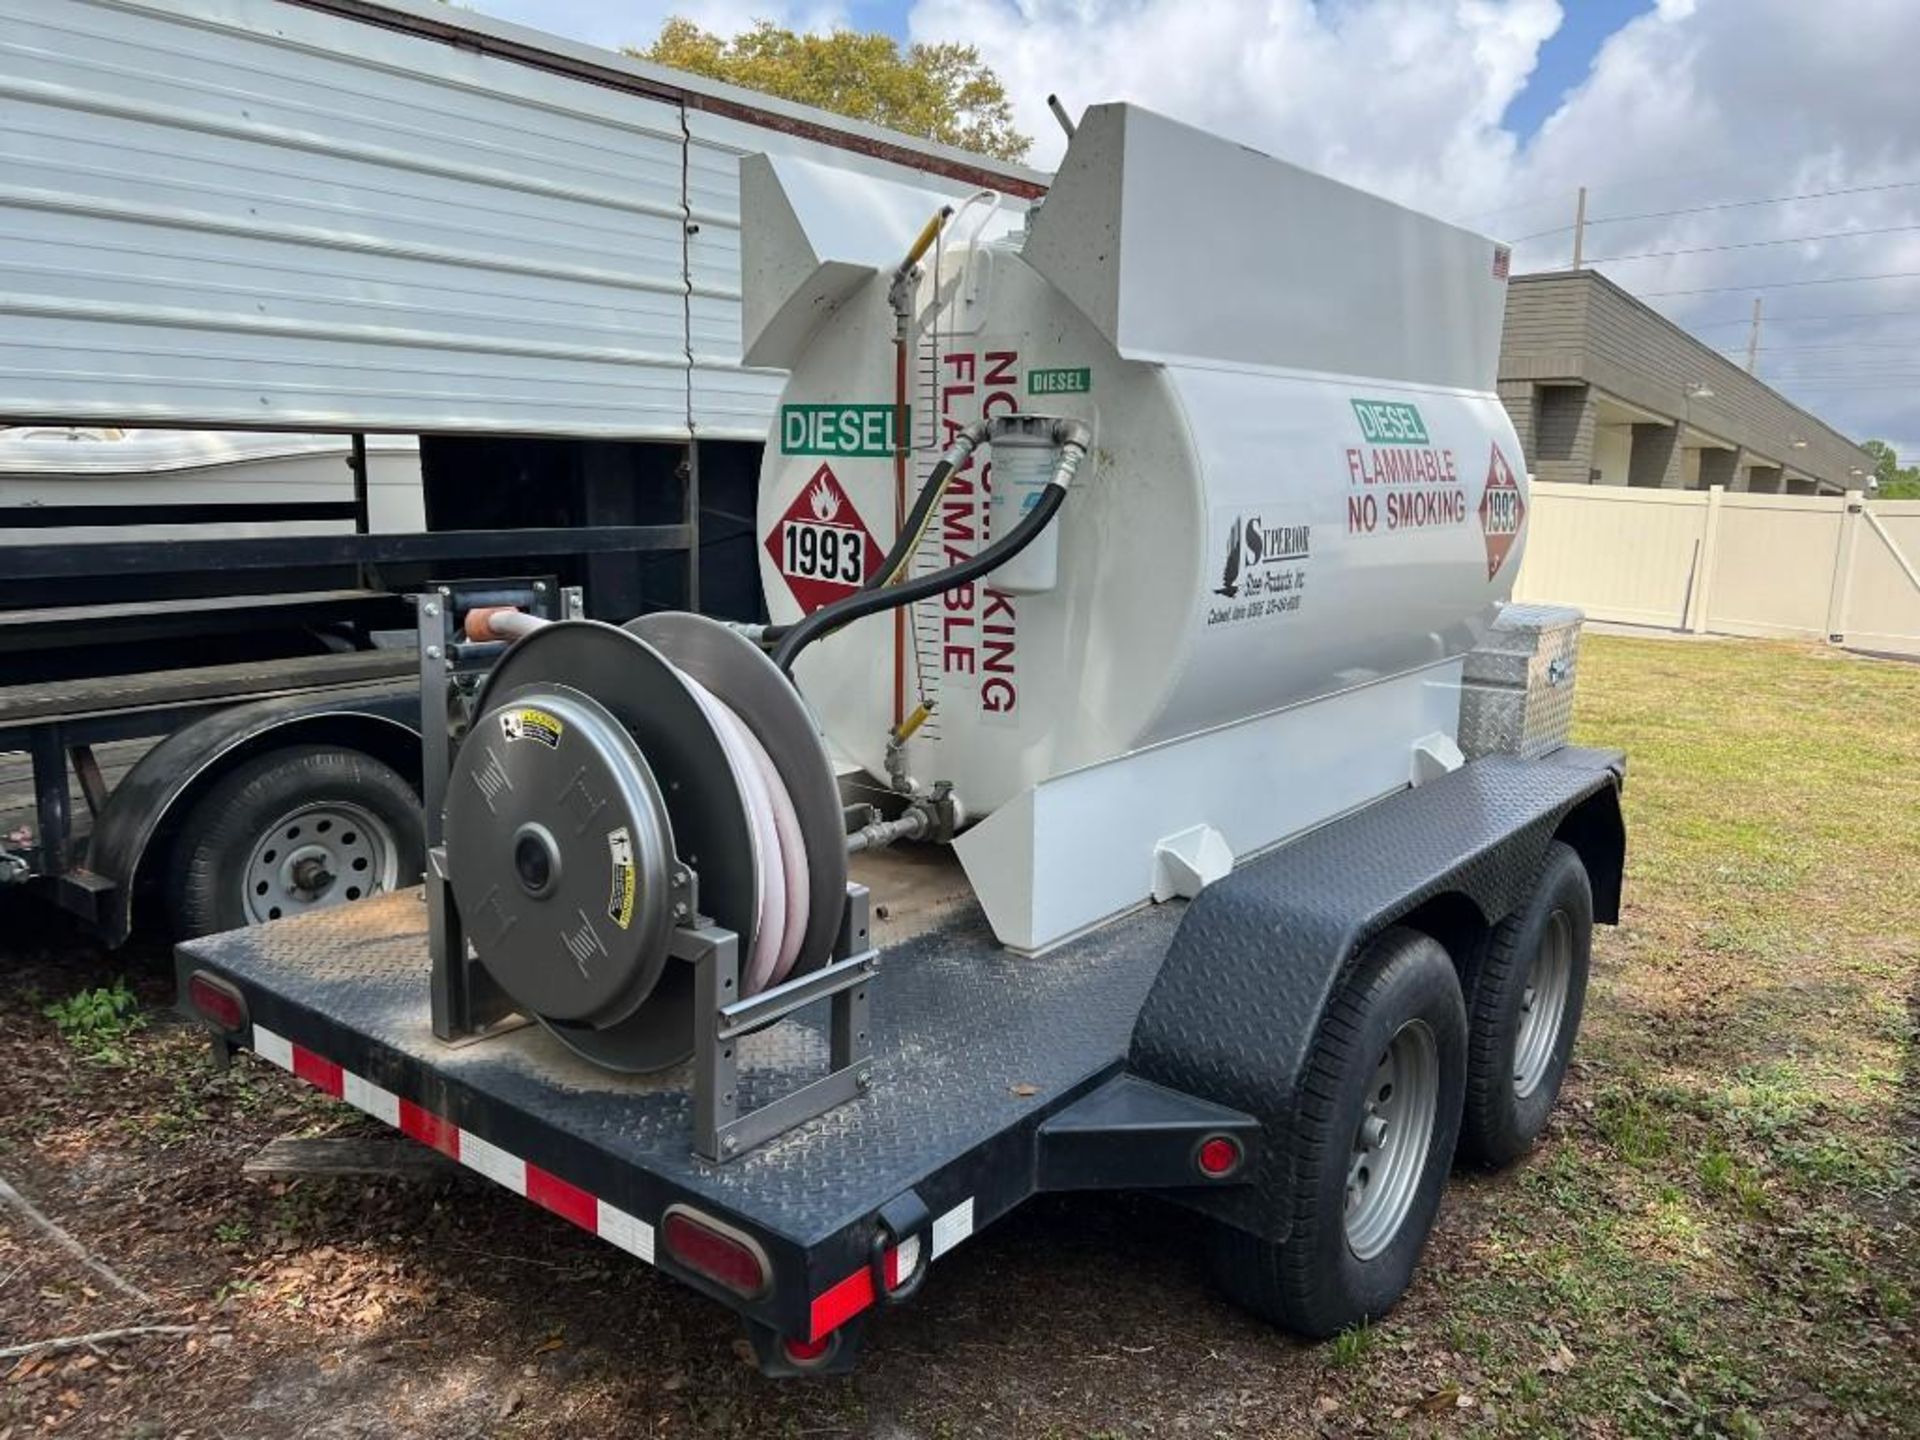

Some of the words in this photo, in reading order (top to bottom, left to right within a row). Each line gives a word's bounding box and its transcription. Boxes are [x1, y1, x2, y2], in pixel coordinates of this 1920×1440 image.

[1033, 372, 1083, 391] DIESEL
[786, 410, 897, 451] DIESEL
[1355, 403, 1426, 440] DIESEL
[1346, 448, 1456, 484] FLAMMABLE
[1348, 494, 1377, 533] NO
[1387, 490, 1465, 530] SMOKING
[1488, 491, 1516, 532] 1993
[786, 525, 861, 583] 1993
